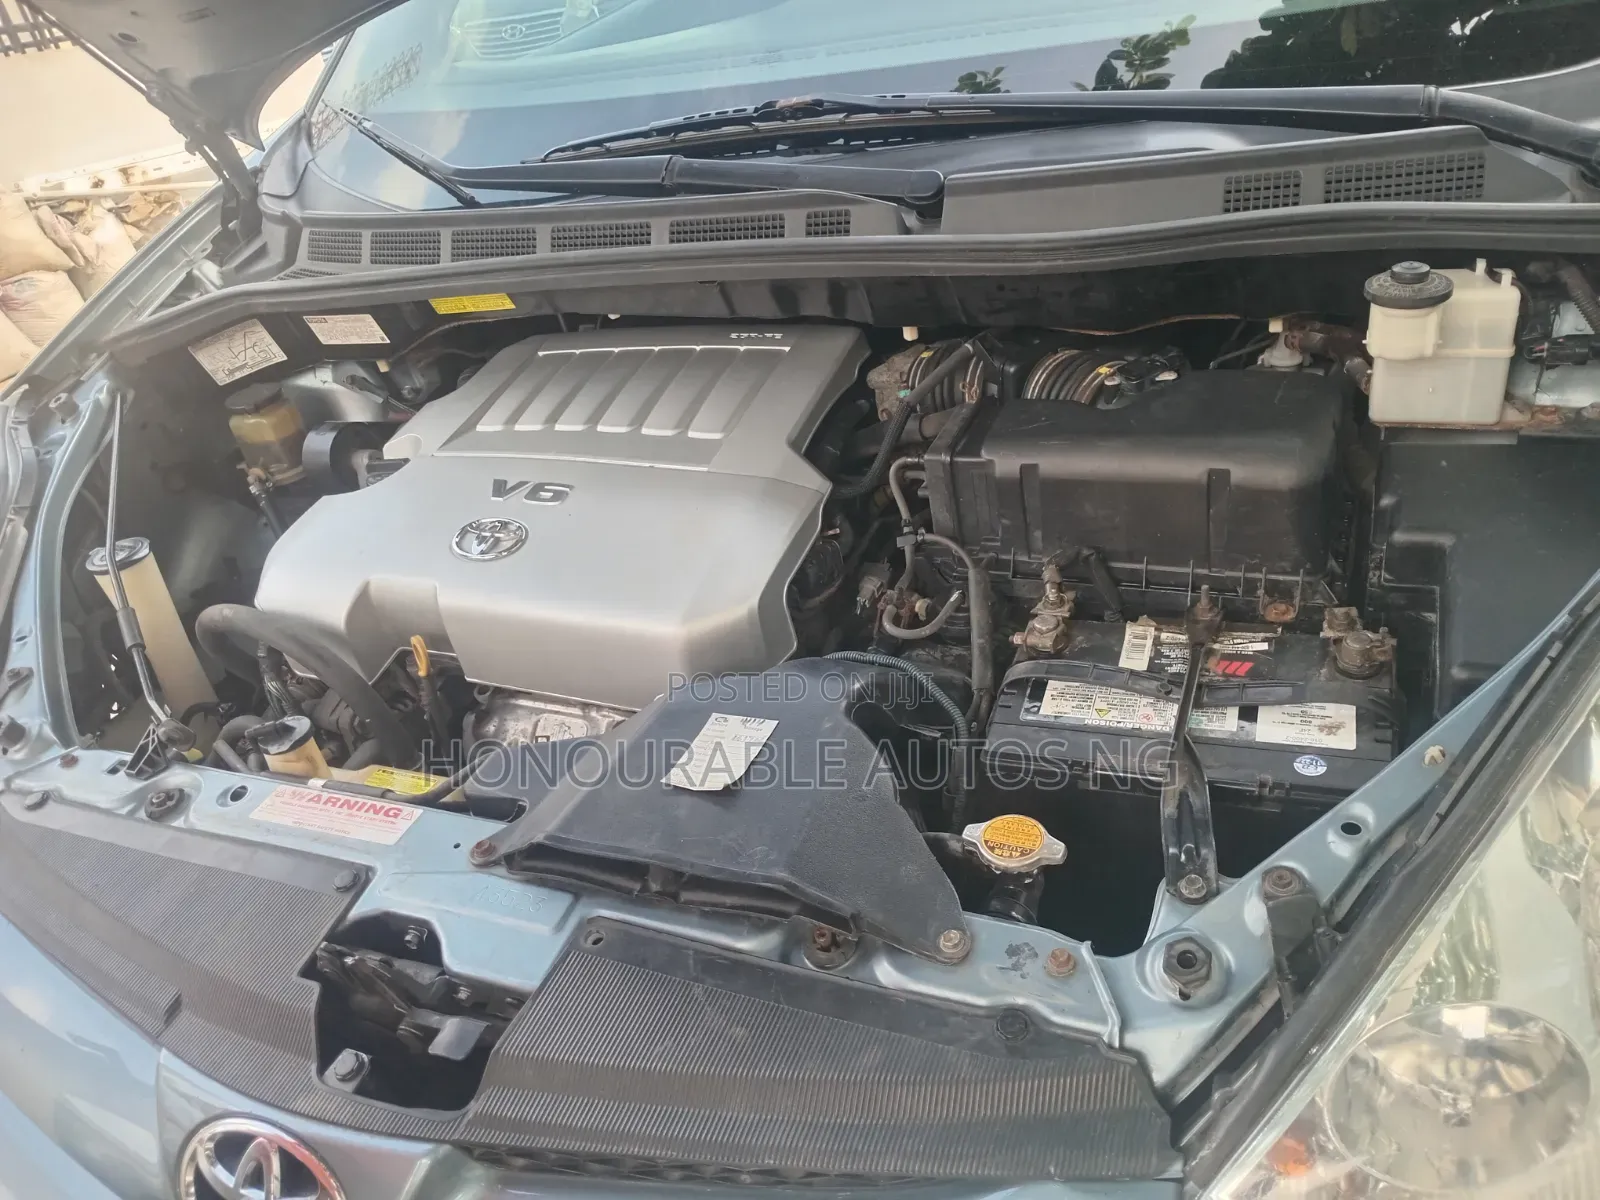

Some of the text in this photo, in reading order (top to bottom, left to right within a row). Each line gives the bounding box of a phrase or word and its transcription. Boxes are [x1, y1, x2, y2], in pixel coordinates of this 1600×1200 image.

[491, 478, 575, 505] V6
[1084, 718, 1171, 733] DANGER/POISON
[287, 787, 404, 820] WARNING
[987, 841, 1030, 854] CAUTION
